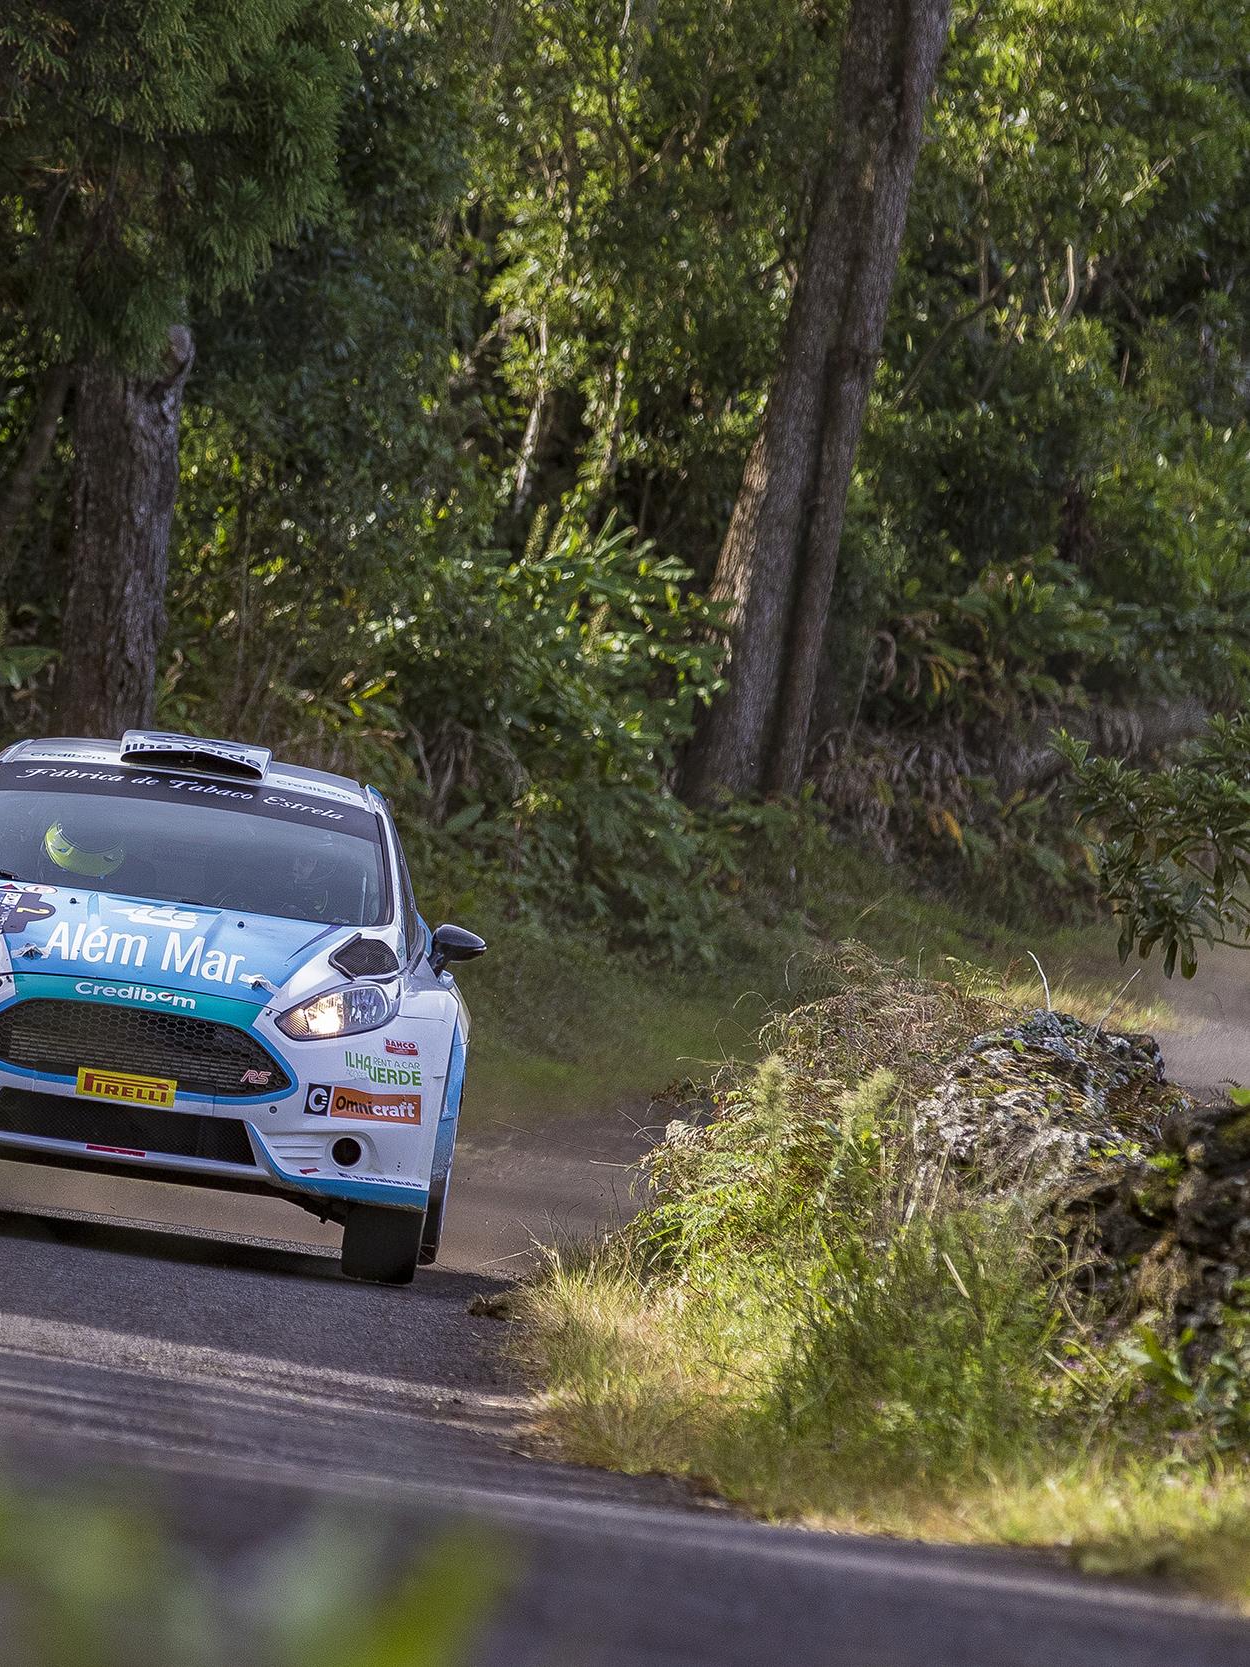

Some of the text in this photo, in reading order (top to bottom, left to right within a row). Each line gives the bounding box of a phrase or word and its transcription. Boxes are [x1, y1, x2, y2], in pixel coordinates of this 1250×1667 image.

[16, 768, 344, 820] Fábrica de Tabaco Estrela
[47, 921, 245, 985] Além Mar
[74, 982, 197, 1010] Credibom
[345, 1051, 372, 1070] ILHA
[83, 1072, 169, 1103] PIRELLI
[240, 1069, 271, 1085] RS
[369, 1066, 422, 1086] VERDE
[336, 1095, 415, 1118] Omnicraft
